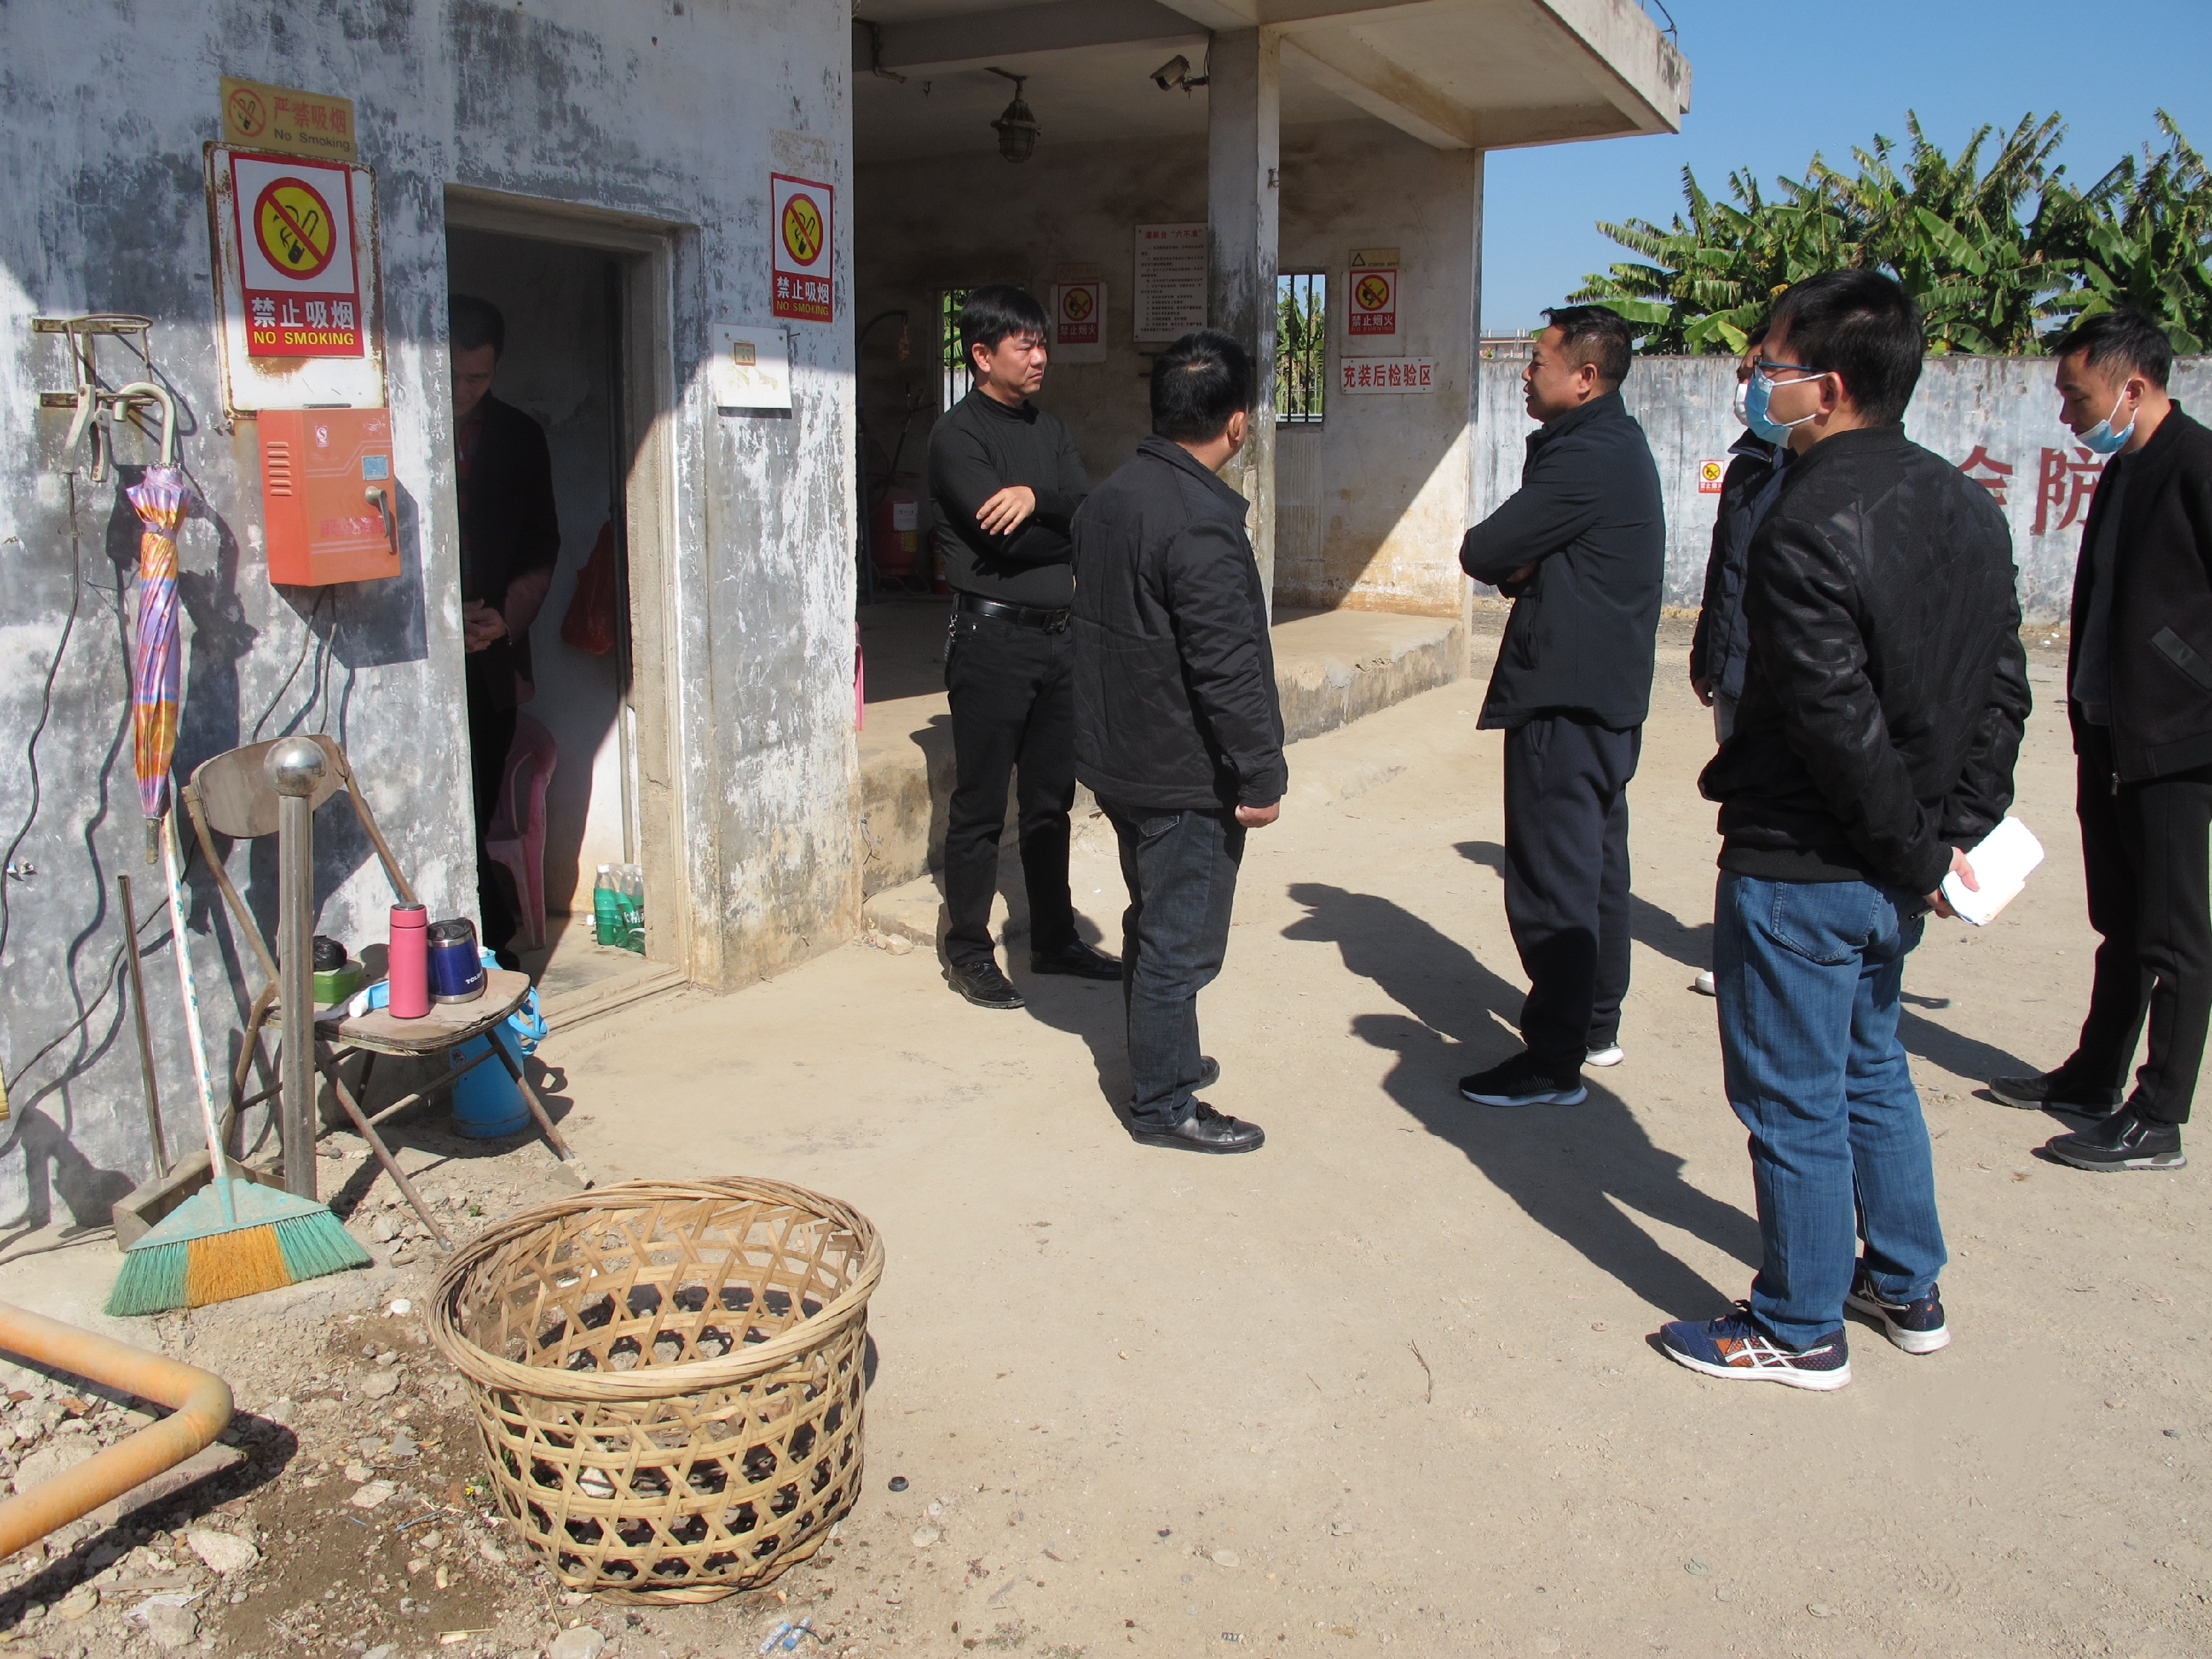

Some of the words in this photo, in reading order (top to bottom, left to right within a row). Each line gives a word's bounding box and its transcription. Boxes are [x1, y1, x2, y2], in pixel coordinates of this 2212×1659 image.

[273, 96, 347, 135] 严禁吸烟
[274, 129, 292, 141] No
[299, 133, 350, 152] Smoking
[776, 276, 829, 305] 禁止吸烟
[251, 297, 355, 331] 禁止吸烟
[776, 300, 789, 310] NO
[793, 302, 829, 316] SMOKING
[1060, 324, 1096, 335] 禁止烟火
[1352, 314, 1394, 327] 禁止烟火
[253, 331, 276, 344] NO
[285, 332, 354, 345] SMOKING
[1343, 364, 1431, 388] 充装后检验区
